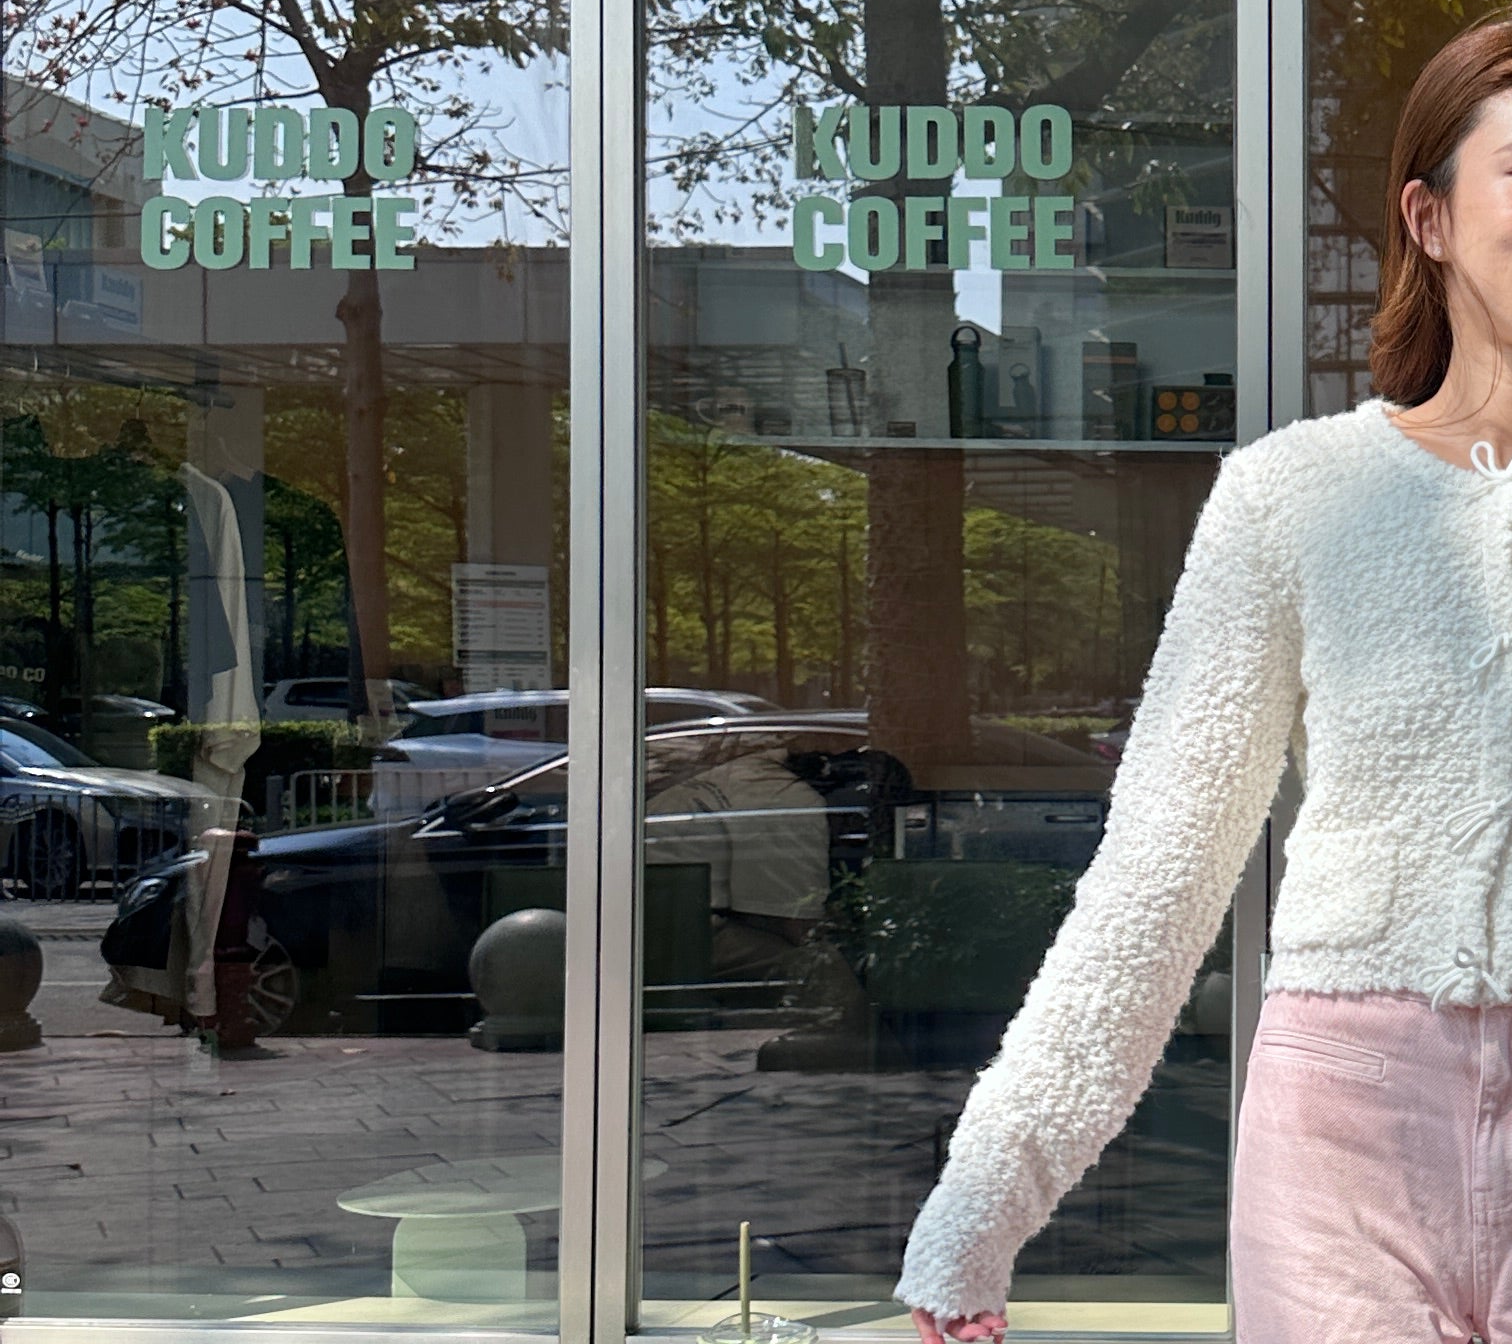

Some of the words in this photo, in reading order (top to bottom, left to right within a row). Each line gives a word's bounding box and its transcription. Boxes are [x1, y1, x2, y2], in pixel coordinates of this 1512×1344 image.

[143, 107, 416, 182] KUDDO
[795, 104, 1073, 181] KUDDO
[140, 195, 416, 271] COFFEE
[793, 195, 1075, 273] COFFEE
